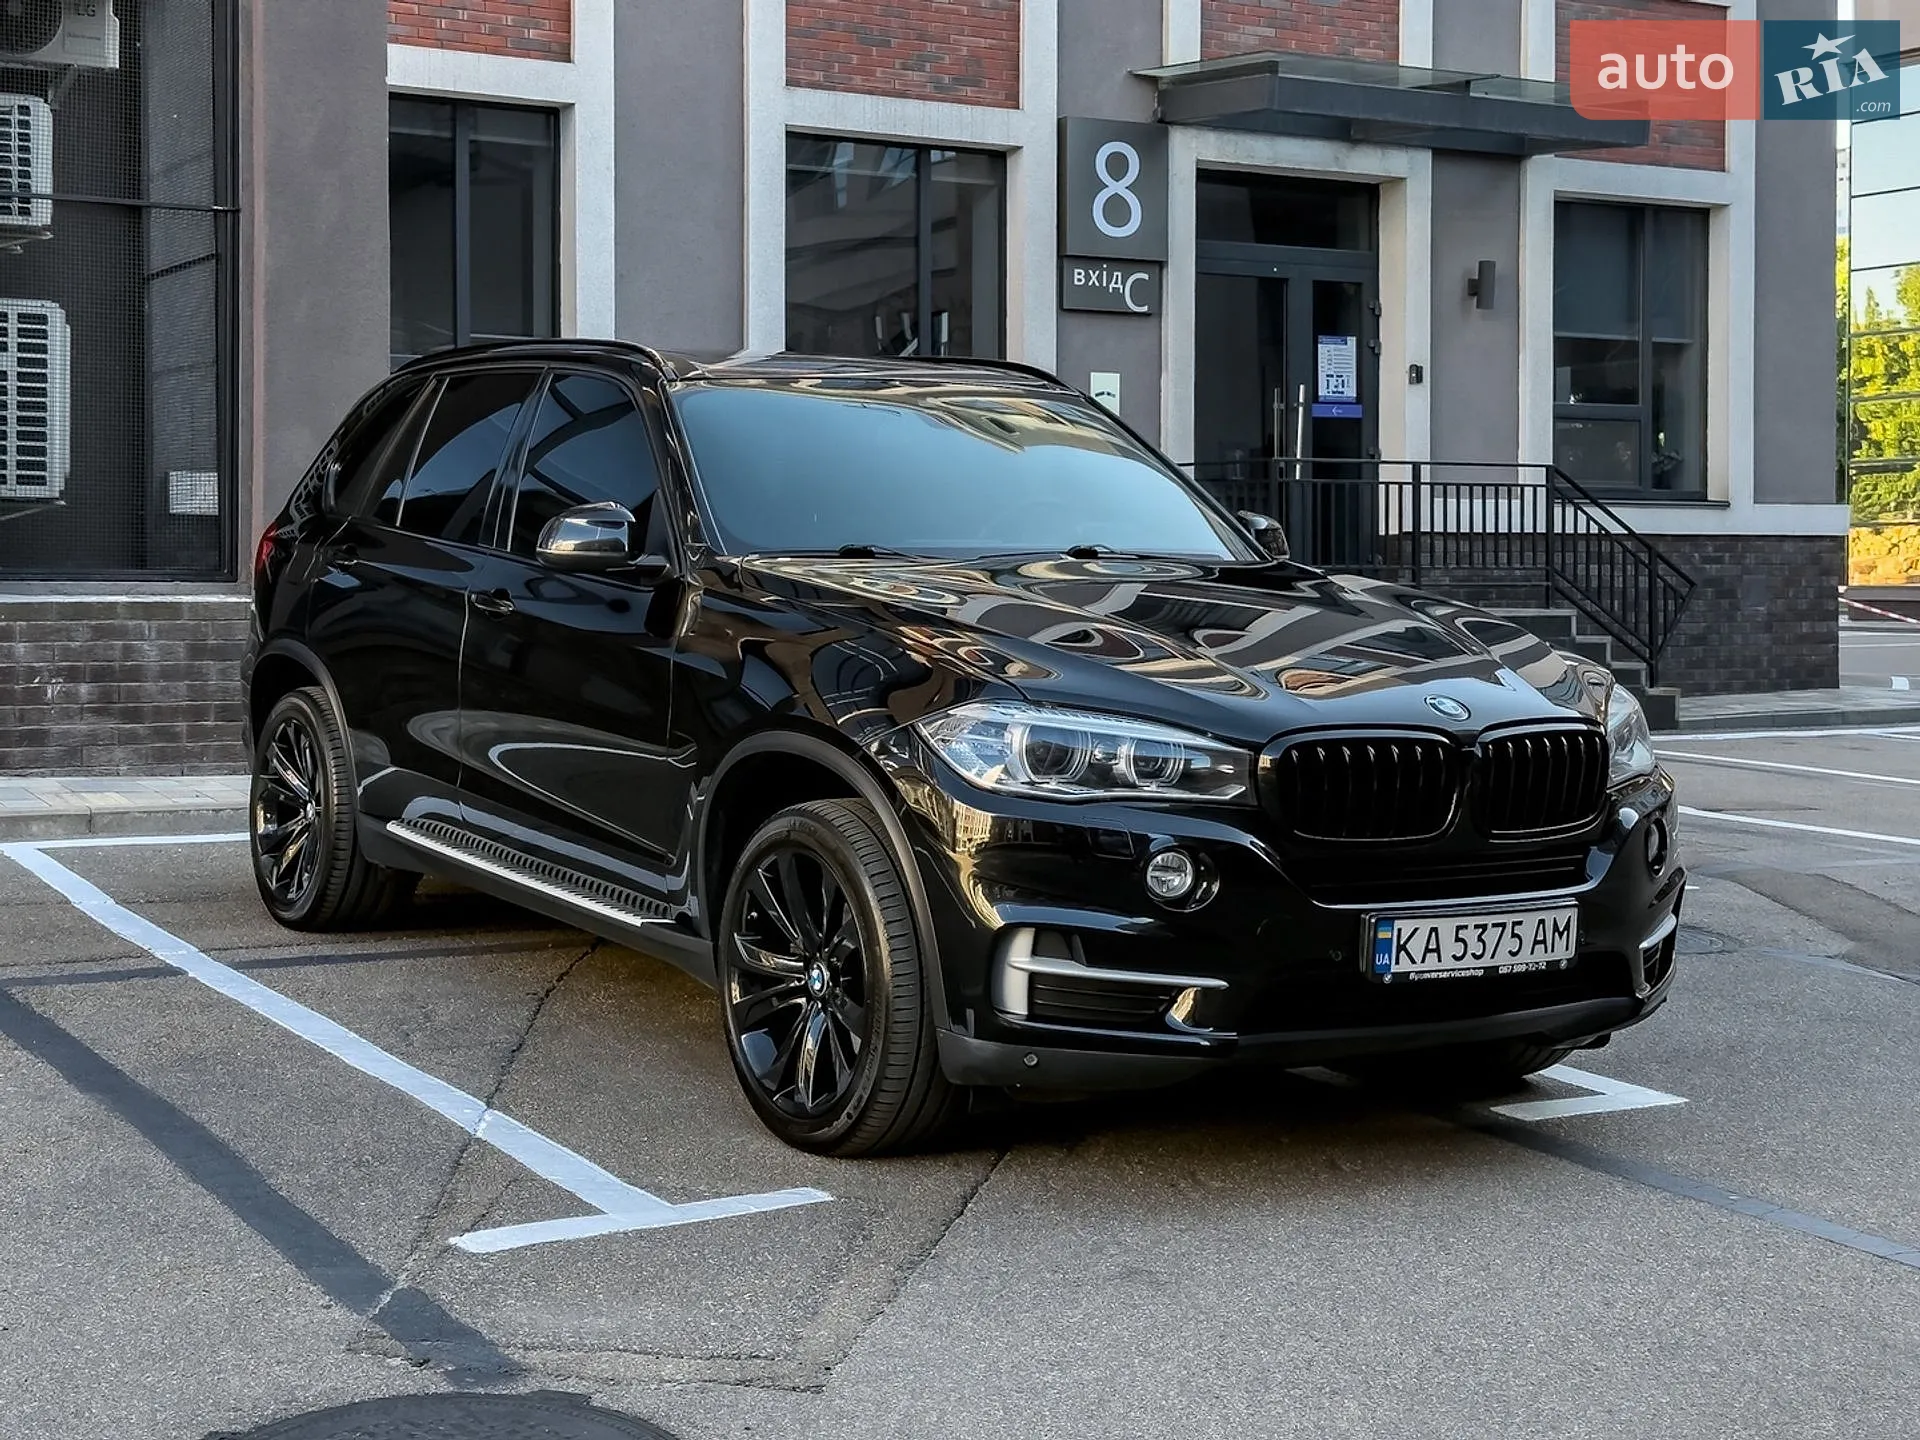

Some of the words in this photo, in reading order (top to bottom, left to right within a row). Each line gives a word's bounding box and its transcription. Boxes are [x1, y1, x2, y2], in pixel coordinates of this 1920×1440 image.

[1093, 141, 1142, 238] 8
[1376, 954, 1390, 965] UA
[1395, 926, 1442, 965] KA
[1452, 920, 1523, 961] 5375
[1530, 915, 1571, 955] AM
